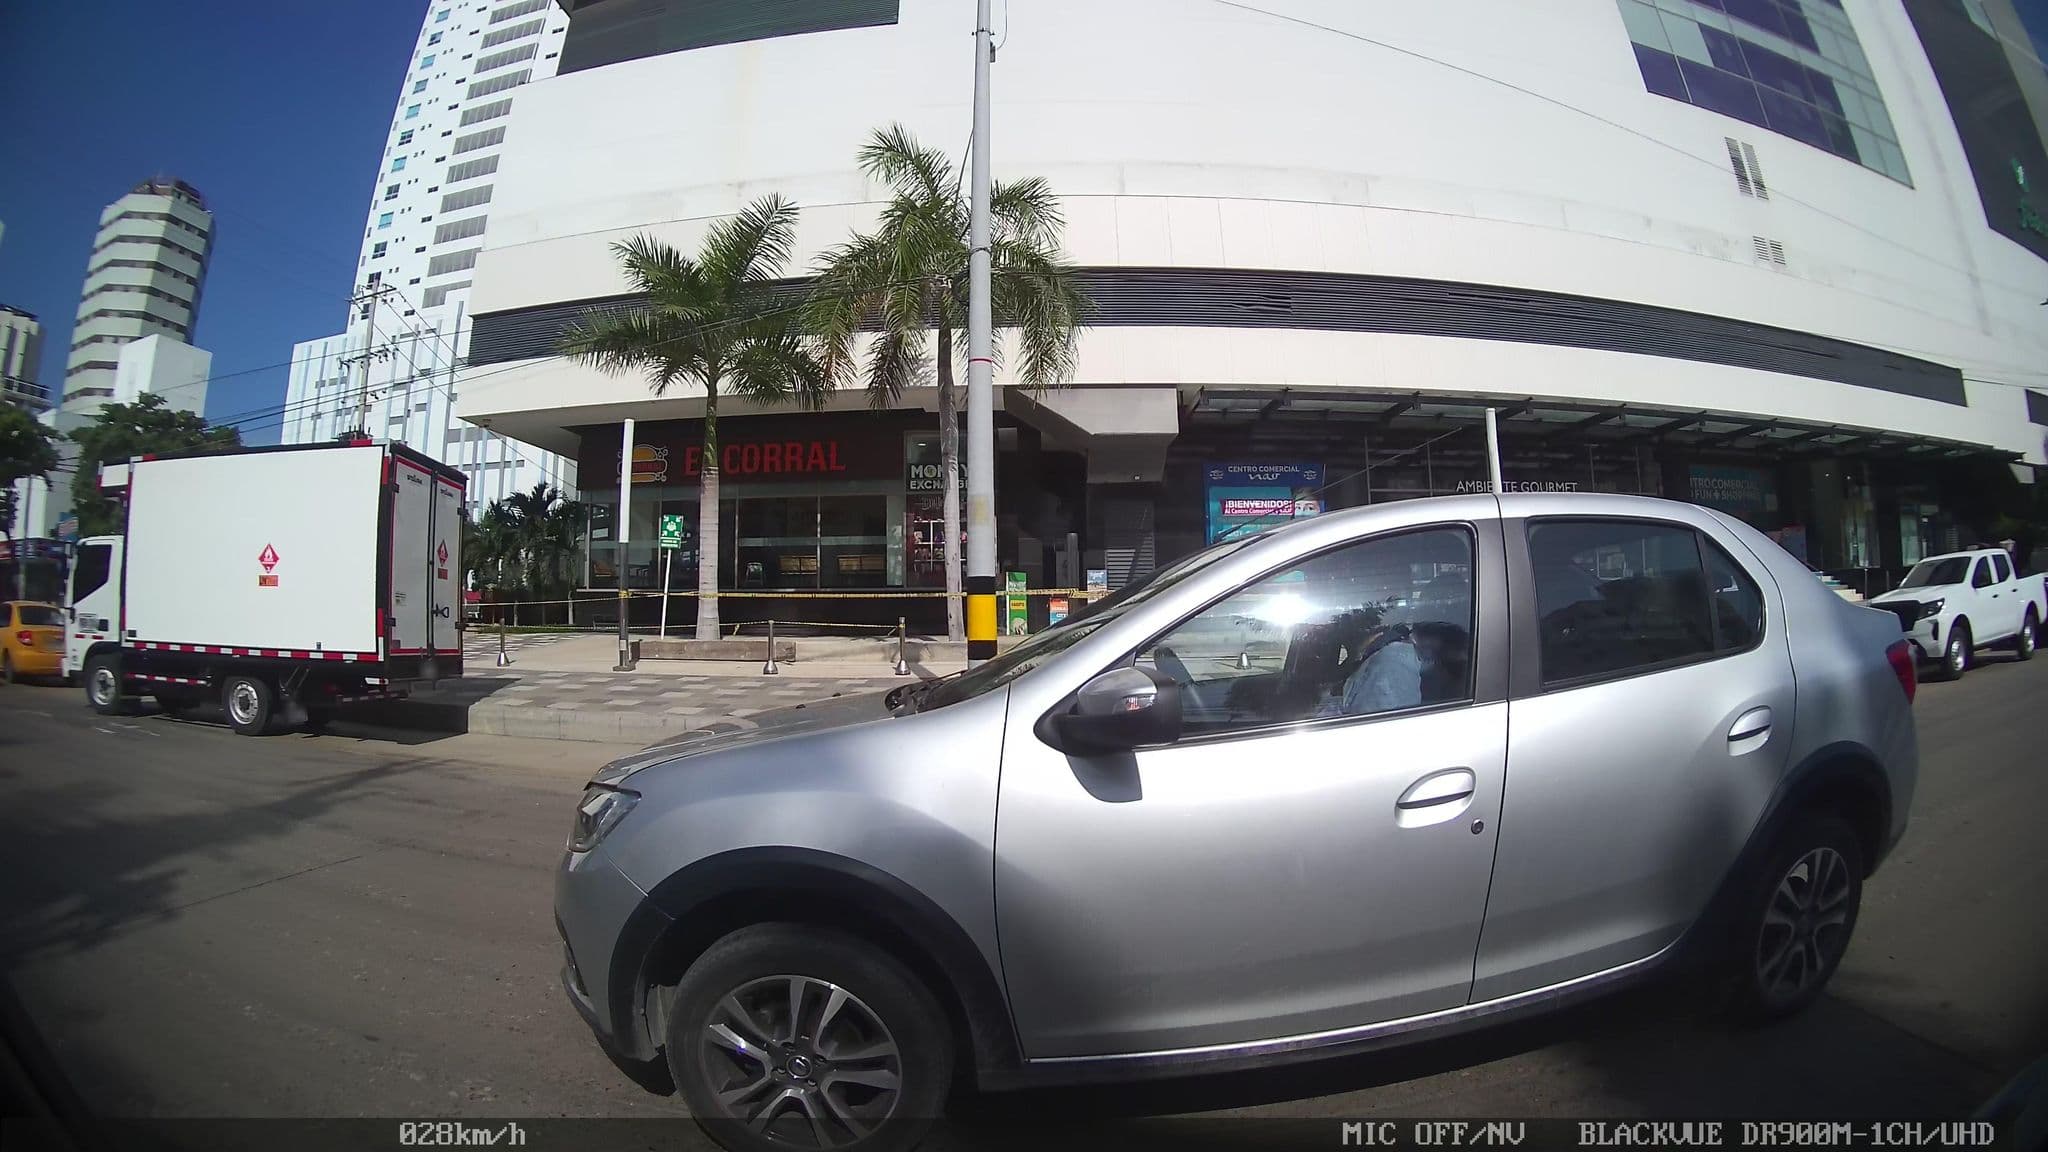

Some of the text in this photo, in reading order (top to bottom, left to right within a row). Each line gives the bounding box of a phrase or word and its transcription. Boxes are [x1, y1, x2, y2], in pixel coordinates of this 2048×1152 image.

[724, 440, 847, 474] CORRAL
[1227, 465, 1300, 473] CENTRO COMERCIAL
[1456, 480, 1578, 493] AMBIETE GOURMET
